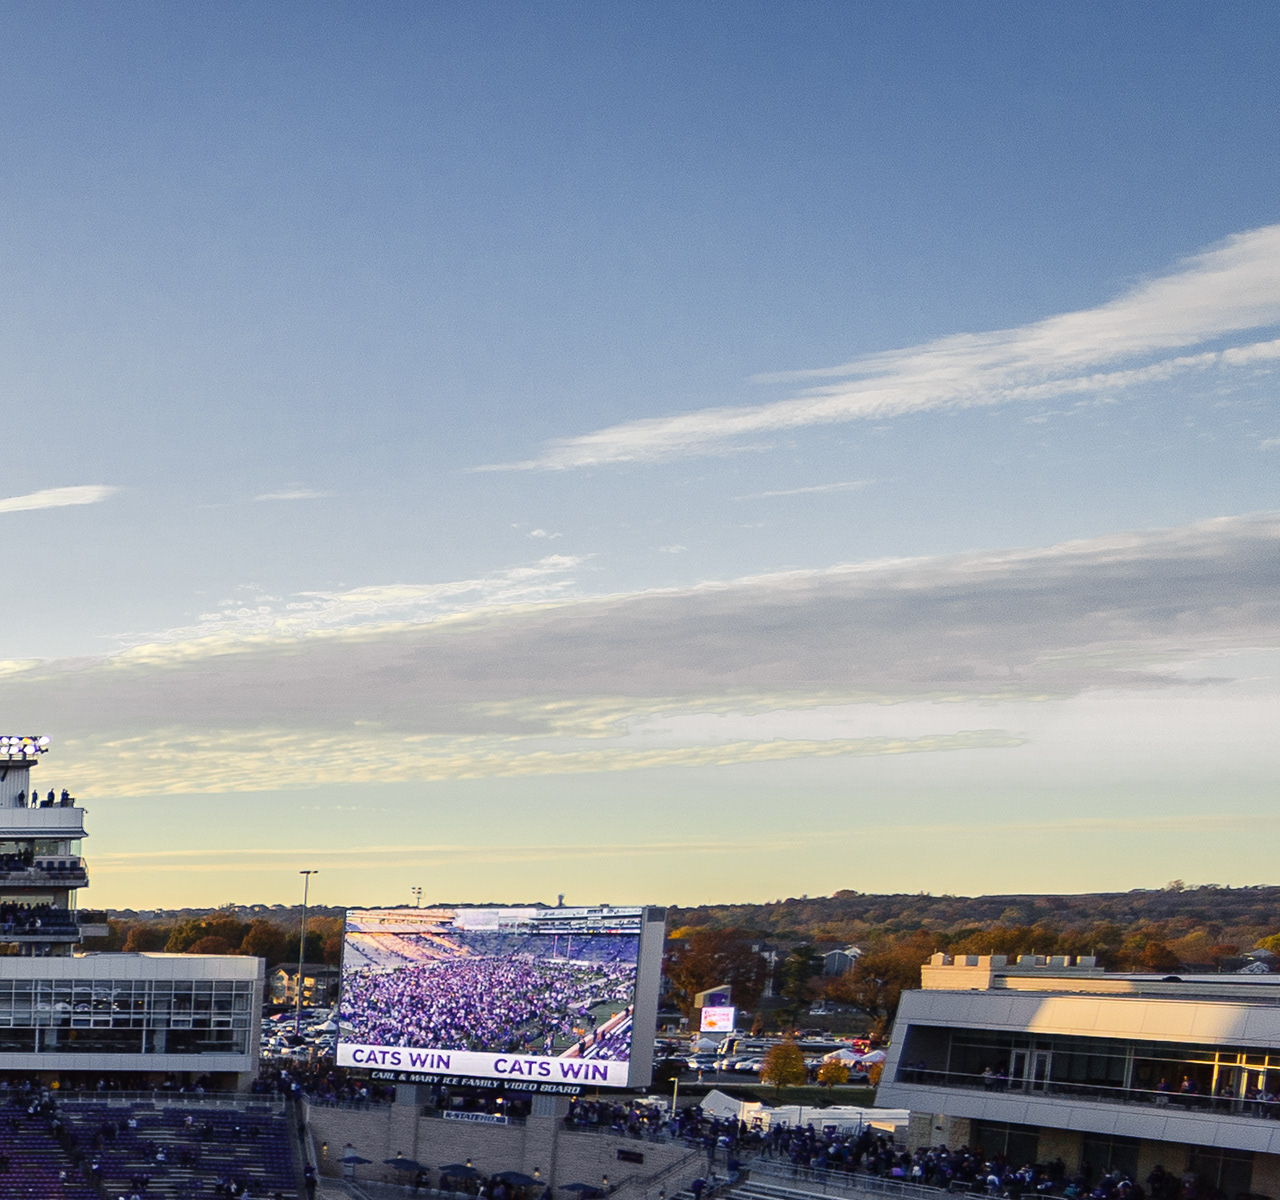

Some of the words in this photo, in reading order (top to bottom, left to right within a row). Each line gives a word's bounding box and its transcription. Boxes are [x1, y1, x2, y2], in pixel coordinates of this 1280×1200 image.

[352, 1049, 401, 1066] CATS
[409, 1052, 451, 1070] WIN
[493, 1058, 551, 1077] CATS
[559, 1062, 608, 1081] WIN
[371, 1071, 397, 1080] CARL
[399, 1073, 407, 1081] &
[410, 1074, 440, 1084] MARY
[442, 1076, 459, 1085] ICE
[461, 1077, 500, 1088] FAMILY
[503, 1081, 537, 1091] VIDEO
[540, 1084, 581, 1094] BOARD
